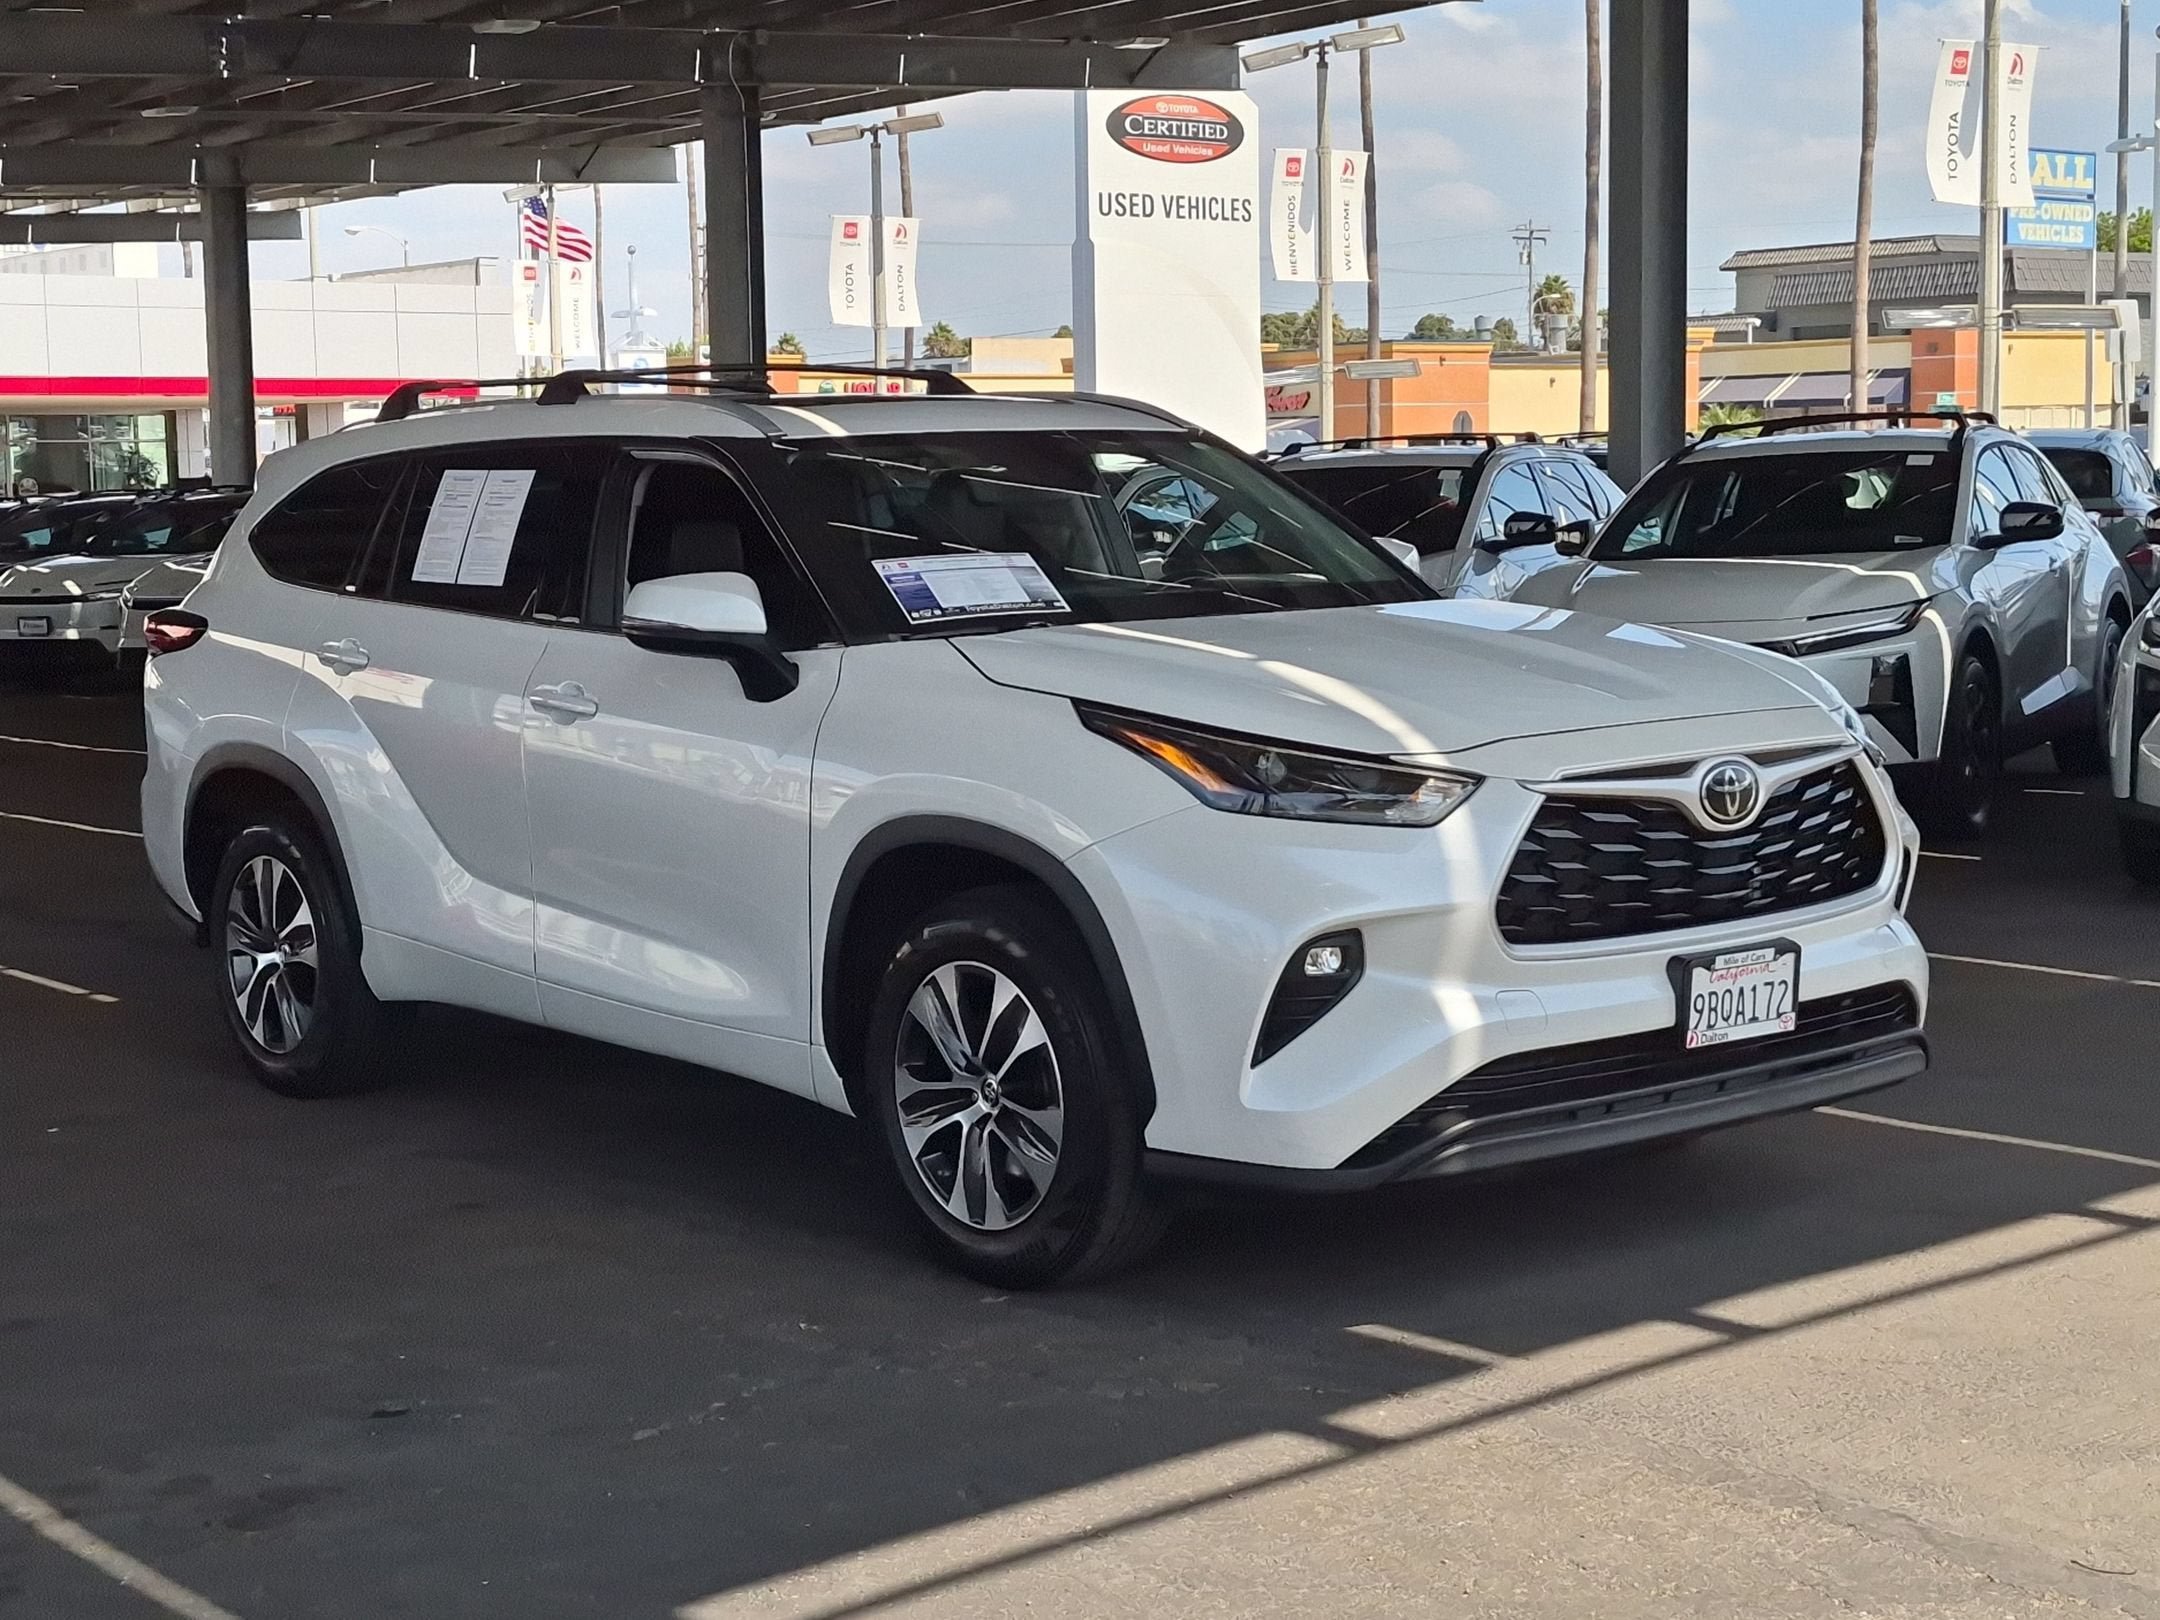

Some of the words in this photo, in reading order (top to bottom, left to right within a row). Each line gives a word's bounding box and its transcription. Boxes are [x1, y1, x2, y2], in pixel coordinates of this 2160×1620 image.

[1169, 103, 1199, 114] TOYOTA
[1123, 115, 1229, 140] CERTIFIED
[1142, 142, 1171, 154] Used
[1172, 144, 1214, 157] Vehicles
[1946, 111, 1960, 182] TOYOTA
[2008, 114, 2018, 185] DALTON
[1098, 191, 1155, 218] USED
[1160, 194, 1253, 223] VEHICLES
[2009, 203, 2092, 223] PRE-OWNED
[1287, 194, 1299, 276] BIENVENIDOS
[1343, 199, 1353, 272] WELCOME
[2017, 222, 2084, 244] VEHICLES
[845, 262, 855, 310] TOYOTA
[896, 264, 906, 312] DALTON
[1723, 956, 1739, 966] Mile
[1741, 954, 1750, 963] of
[1750, 952, 1766, 961] Cars
[1692, 979, 1789, 1030] 9BQA172
[1700, 1031, 1729, 1044] Dalton
